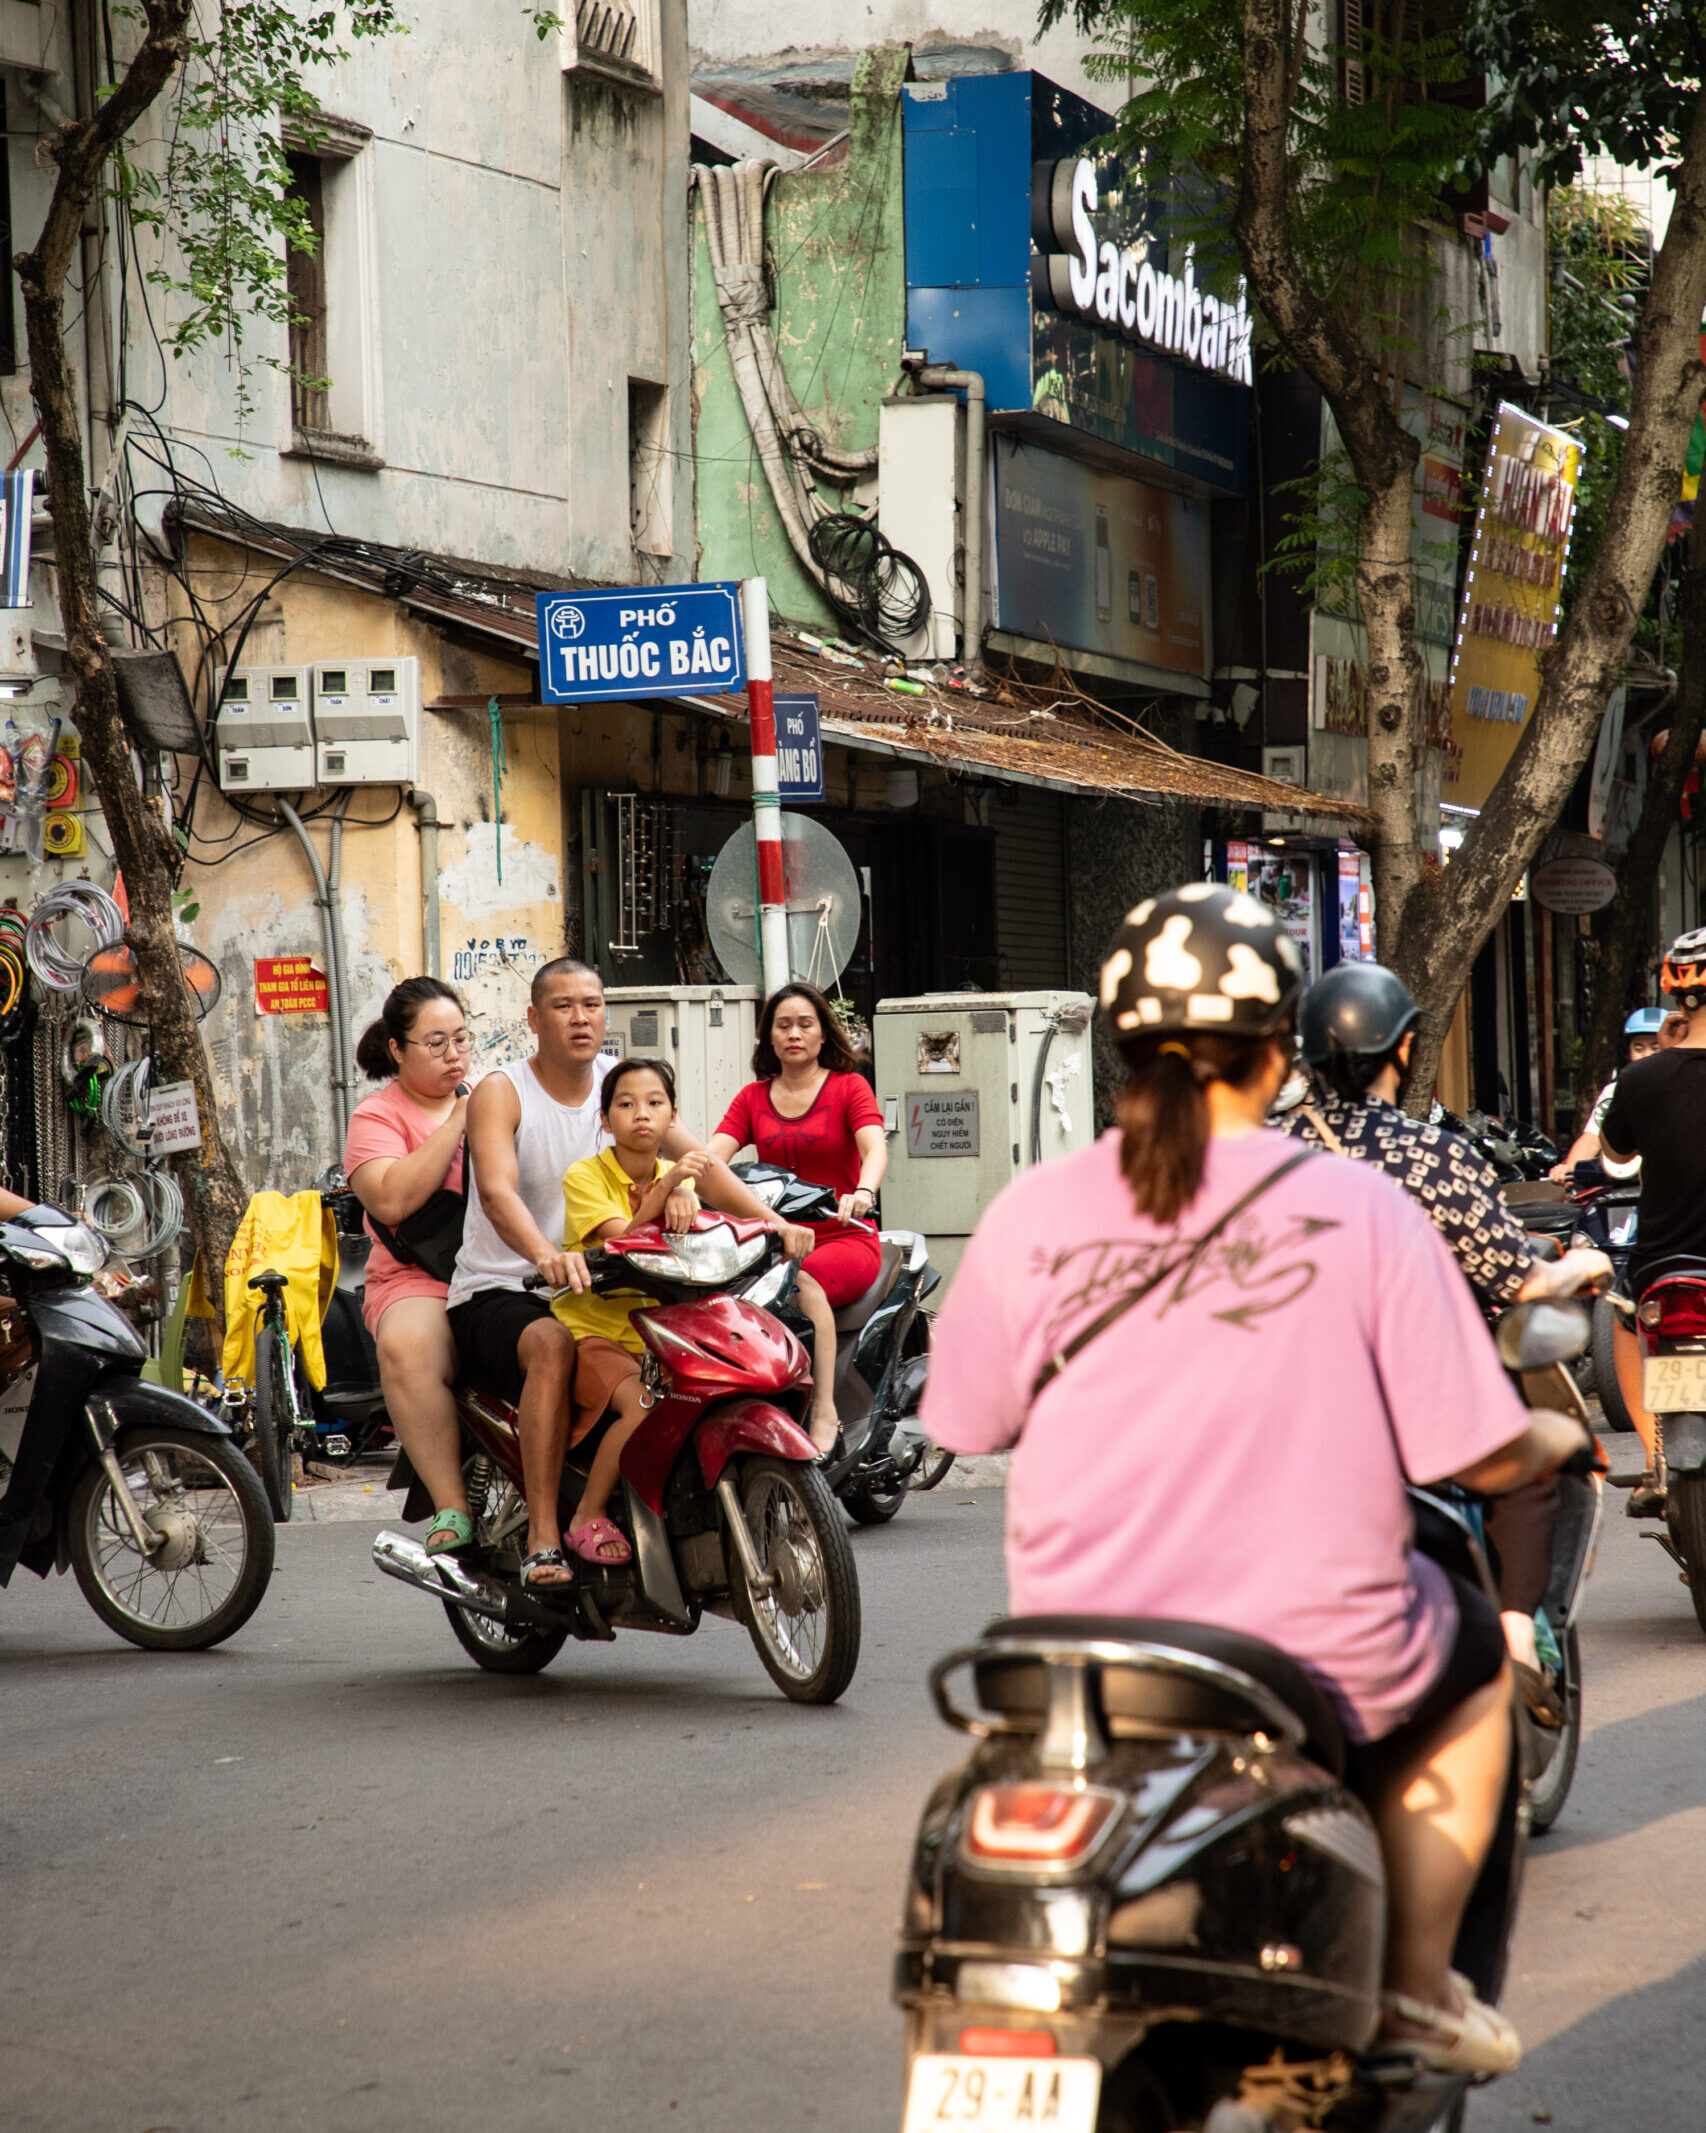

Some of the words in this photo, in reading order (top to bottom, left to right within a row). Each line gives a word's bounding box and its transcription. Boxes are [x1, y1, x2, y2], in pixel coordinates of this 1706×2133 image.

[1069, 157, 1253, 387] Sacombank
[619, 601, 678, 628] PHỐ
[560, 631, 660, 682] THUỐC
[669, 626, 732, 676] BẮC
[786, 711, 804, 736] PHỐ
[670, 1392, 702, 1404] HONDA
